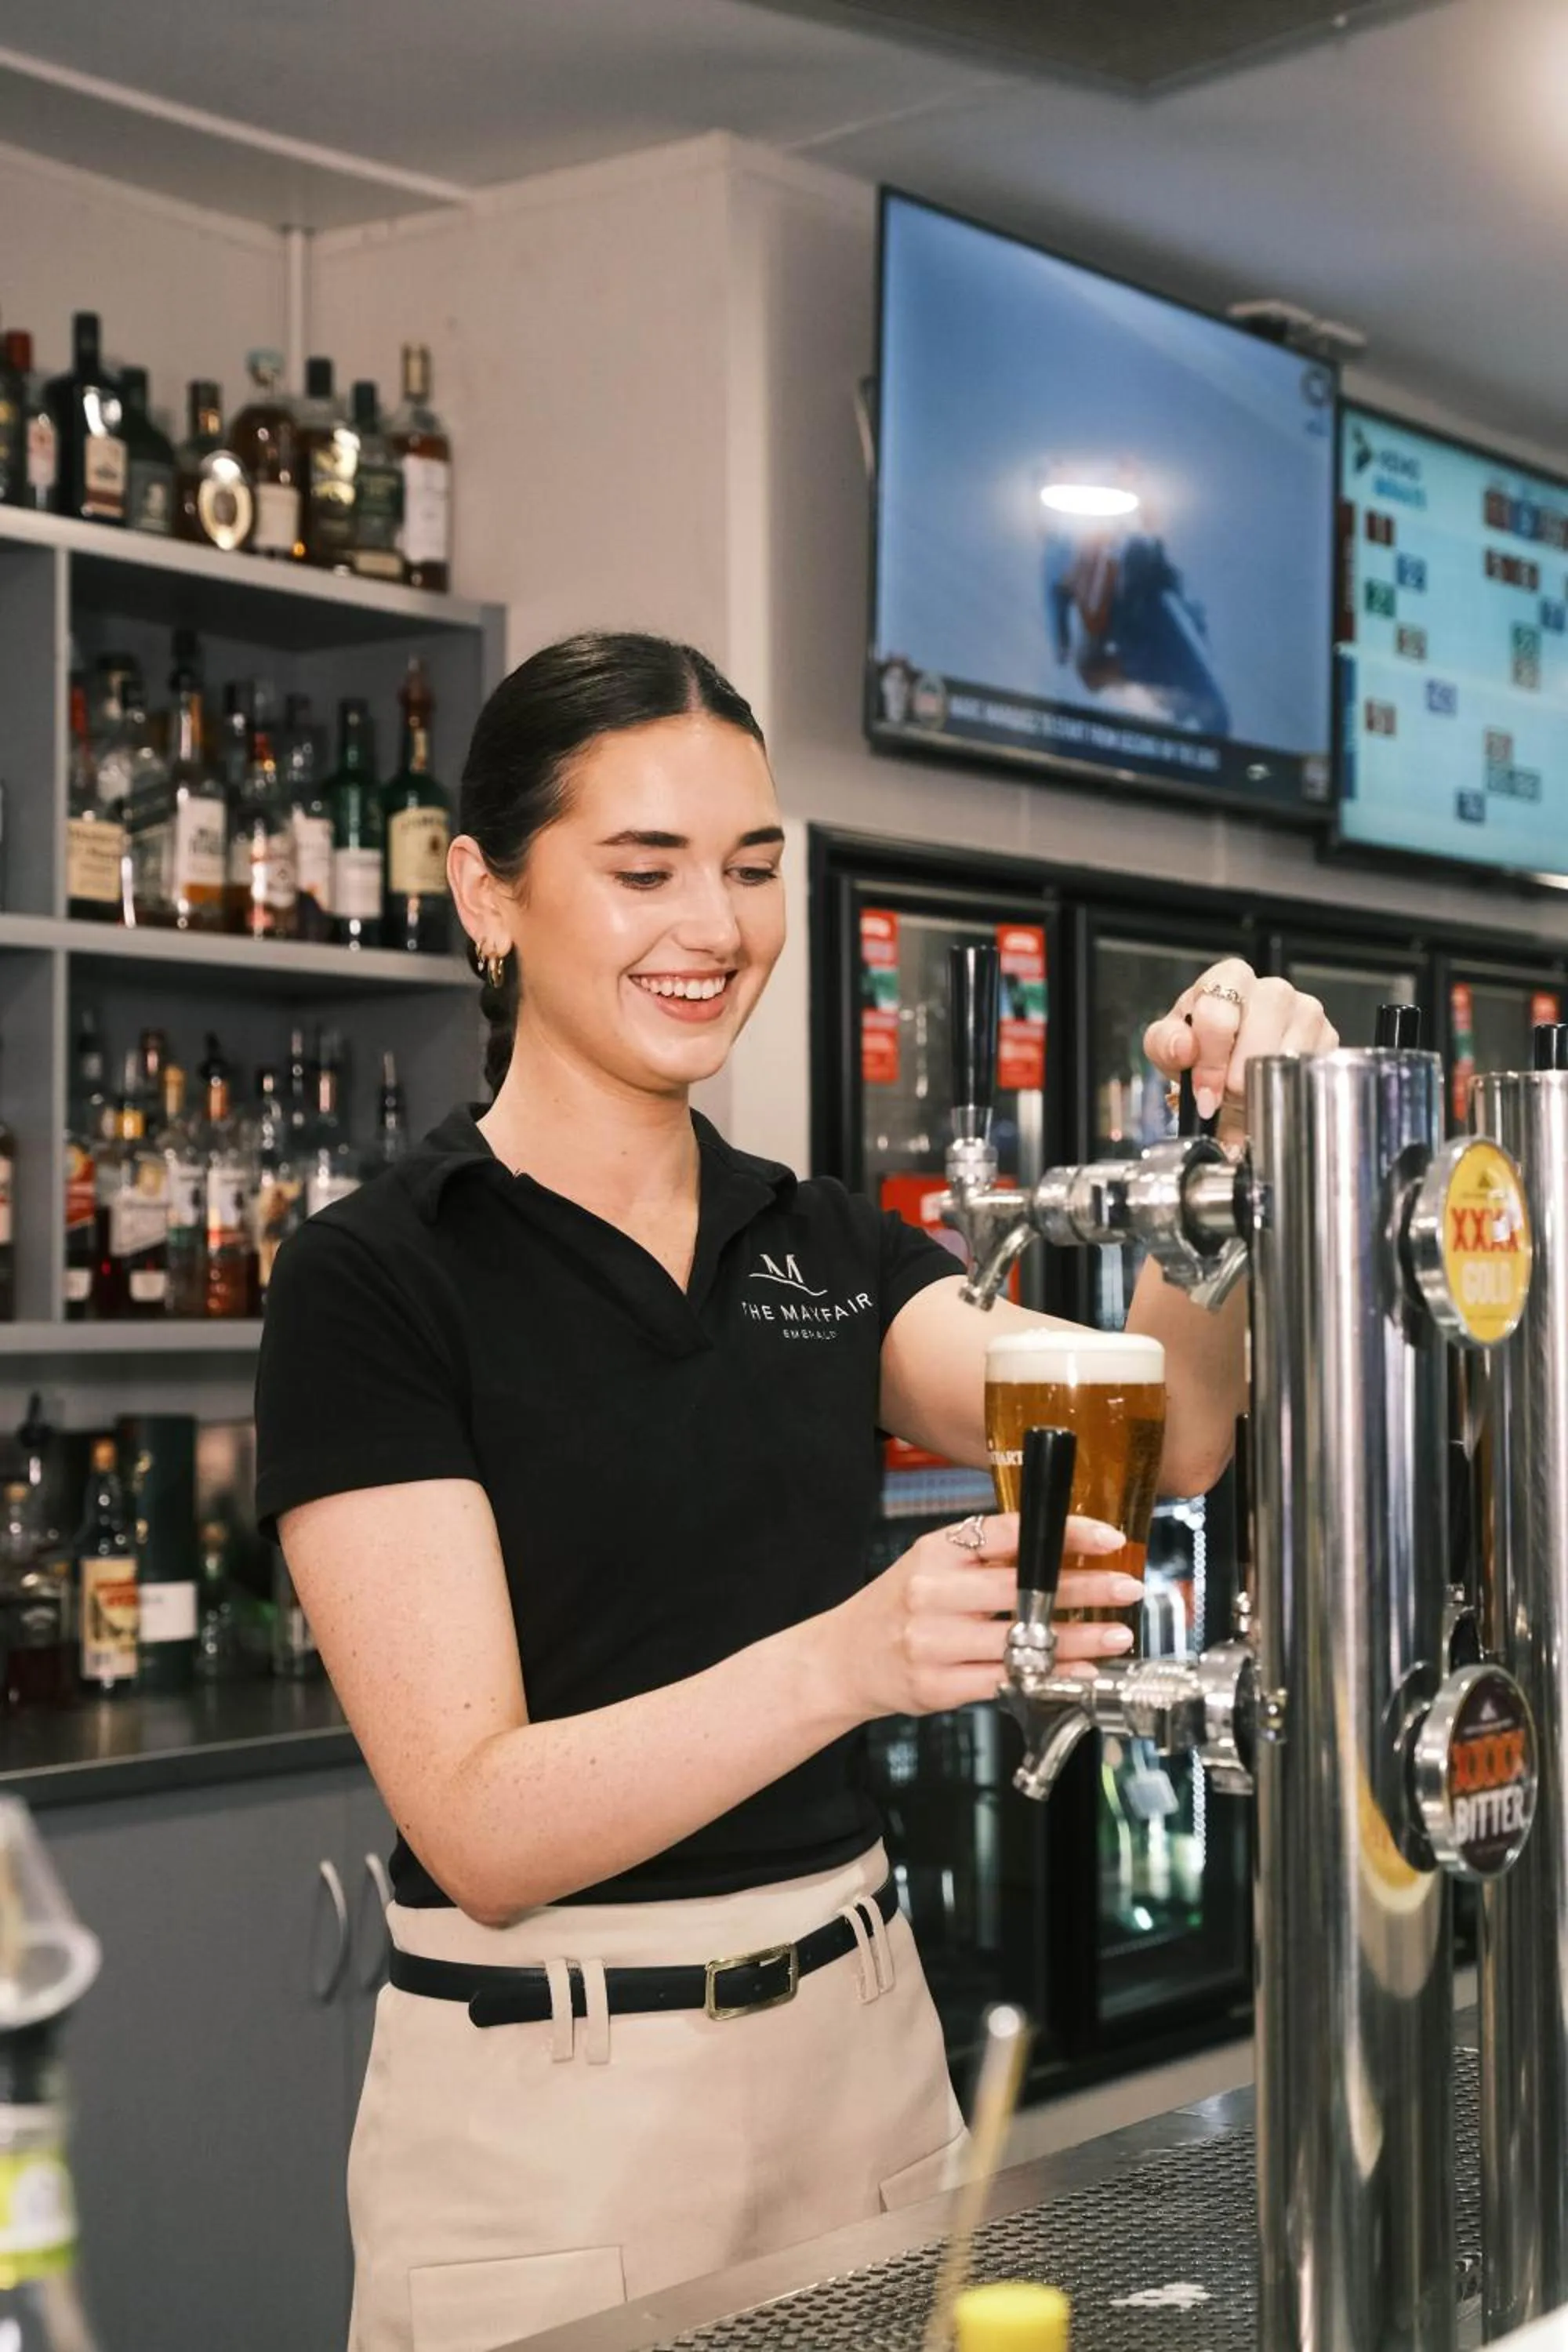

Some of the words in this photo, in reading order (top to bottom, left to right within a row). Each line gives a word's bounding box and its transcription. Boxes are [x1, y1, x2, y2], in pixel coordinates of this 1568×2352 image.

[760, 1254, 804, 1284] M
[741, 1301, 775, 1321] THE
[780, 1293, 873, 1323] MAYFAIR
[1453, 1784, 1526, 1843] BITTER
